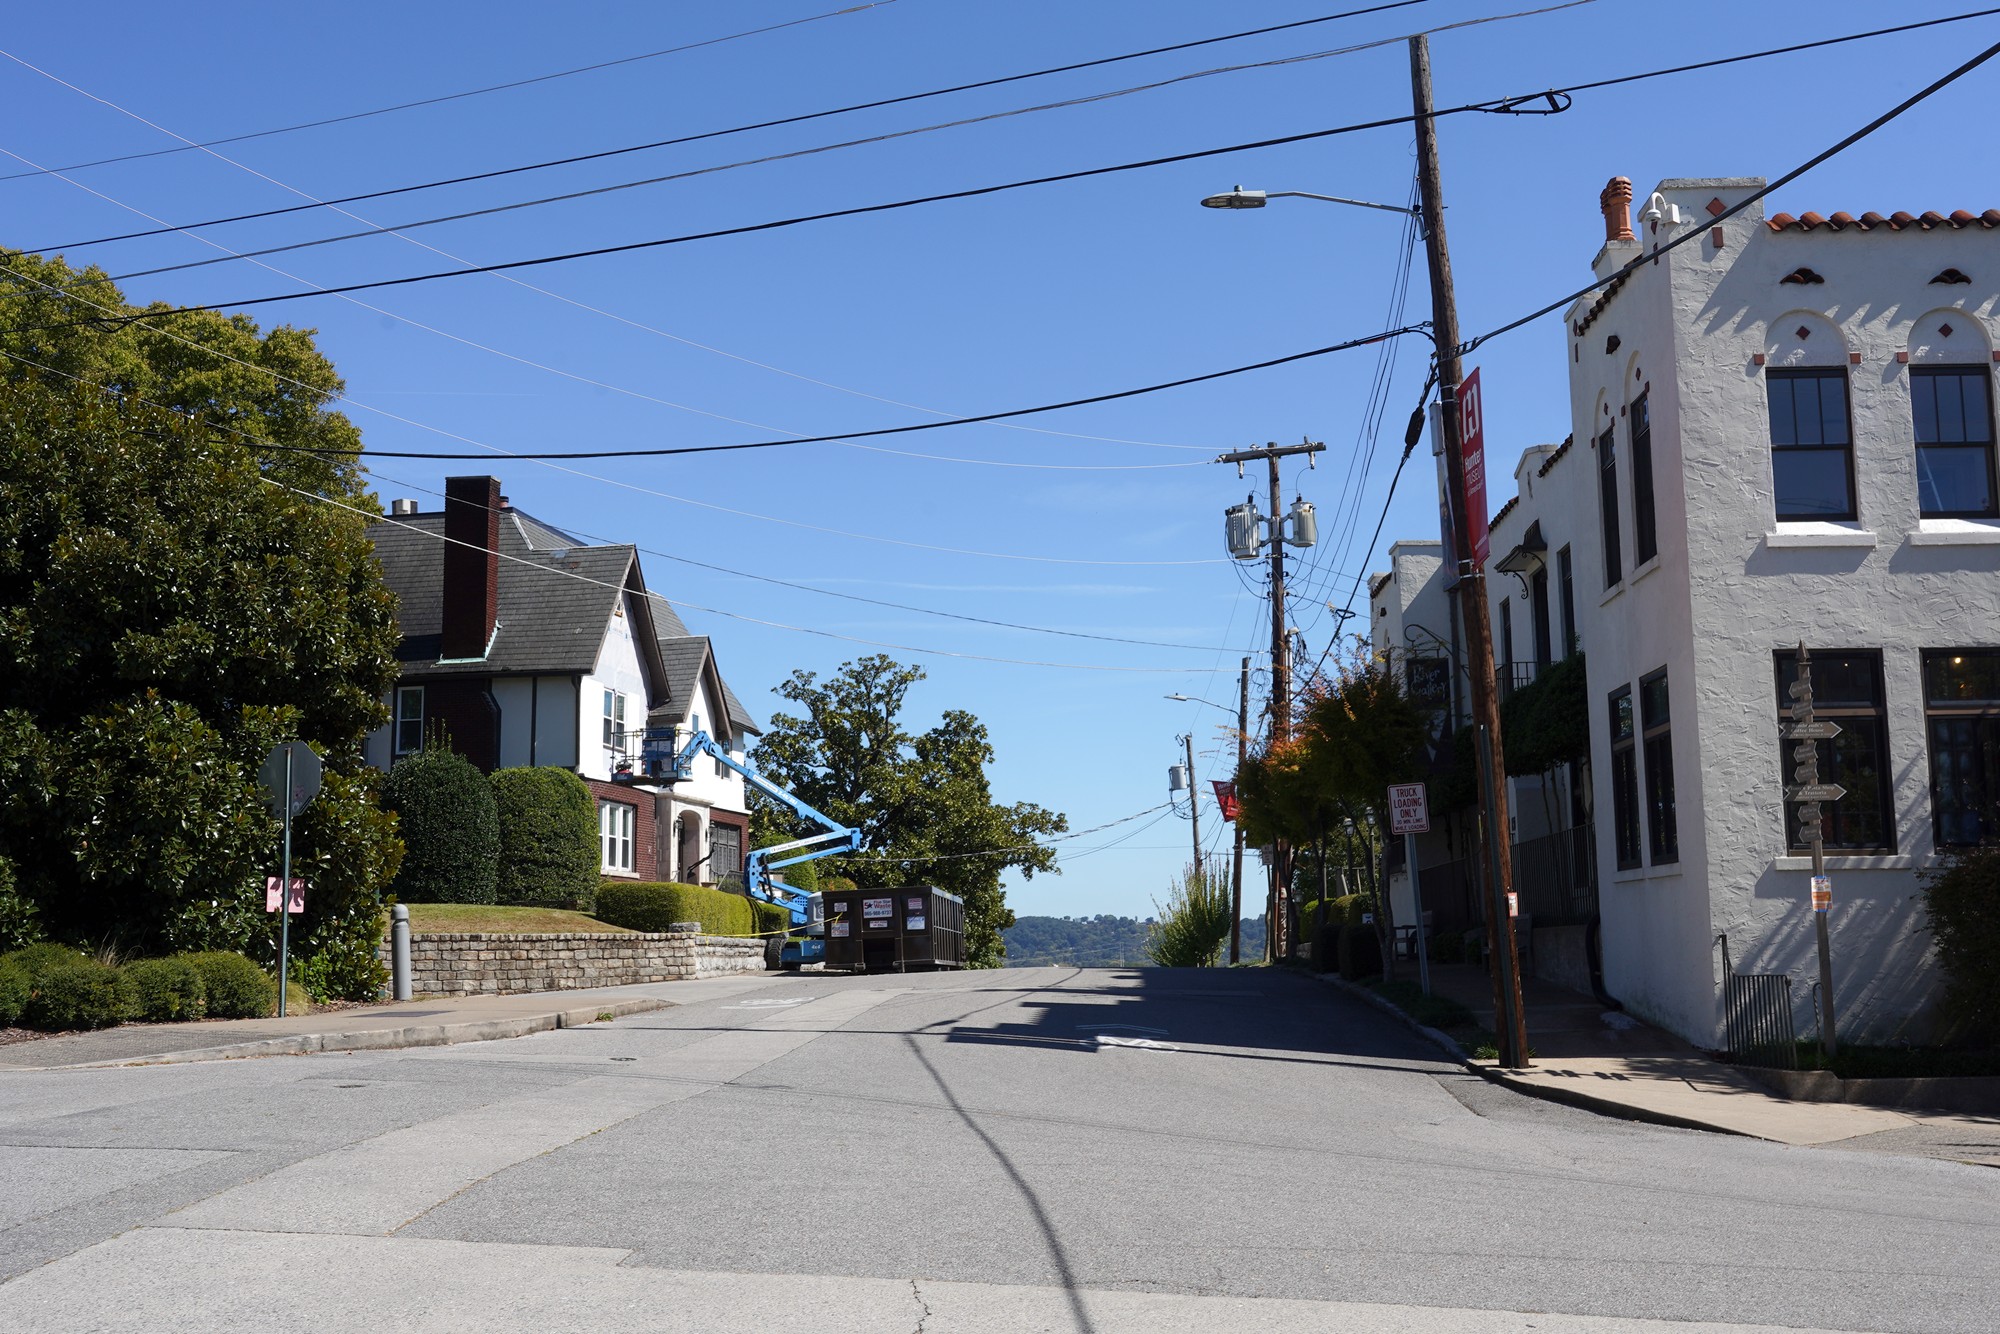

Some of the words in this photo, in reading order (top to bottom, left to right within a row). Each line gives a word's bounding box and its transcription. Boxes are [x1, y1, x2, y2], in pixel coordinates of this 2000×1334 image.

[1413, 665, 1440, 683] River
[1411, 682, 1446, 700] Gallery
[1396, 787, 1417, 798] TRUCK
[1393, 797, 1422, 808] LOADING
[1400, 808, 1417, 818] ONLY
